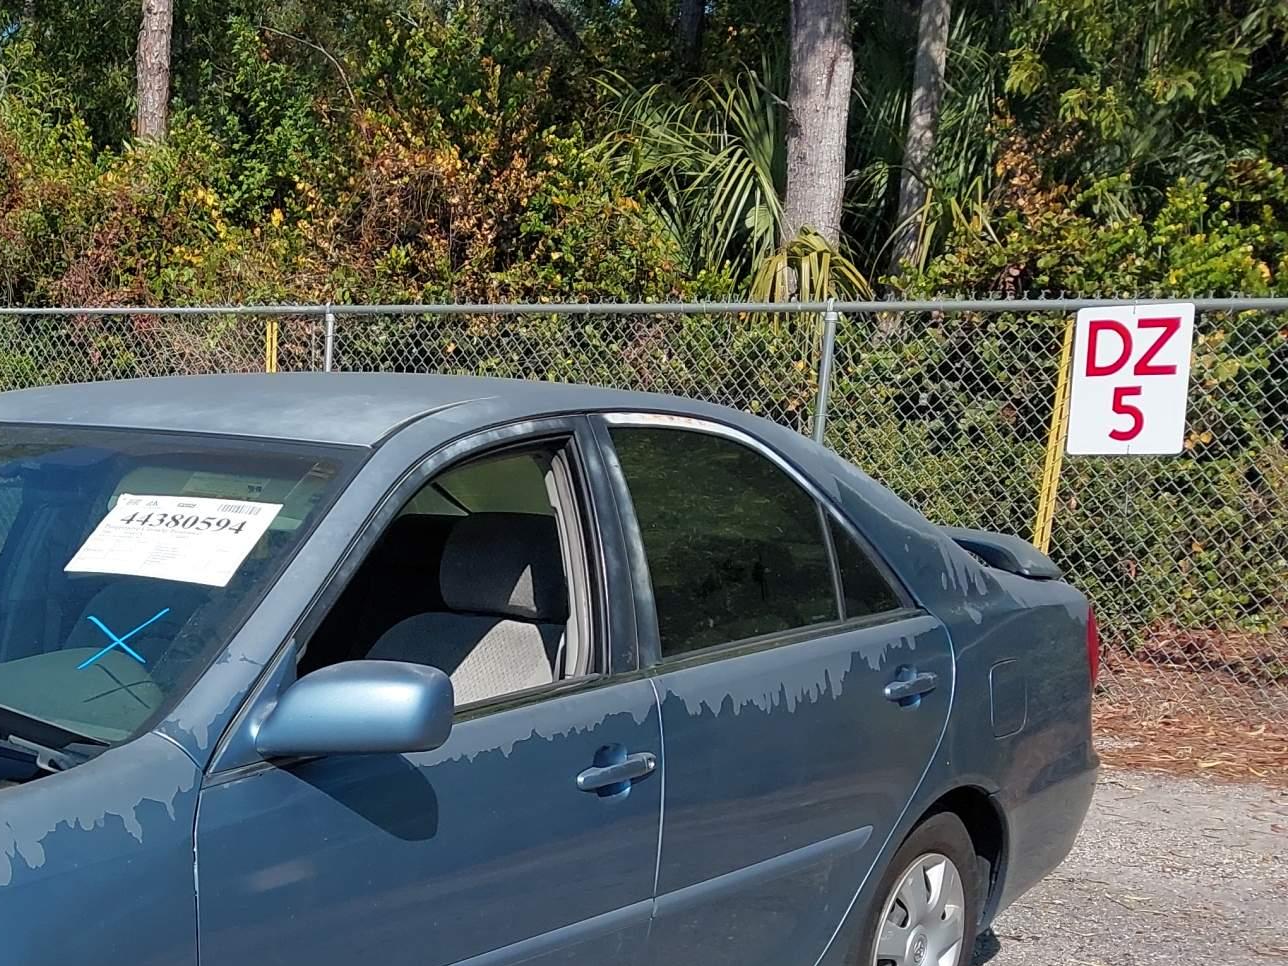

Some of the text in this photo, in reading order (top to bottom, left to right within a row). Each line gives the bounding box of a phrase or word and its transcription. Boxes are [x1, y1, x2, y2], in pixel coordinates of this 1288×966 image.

[1086, 317, 1182, 377] DZ
[1108, 386, 1144, 441] 5
[120, 512, 247, 534] 44380594
